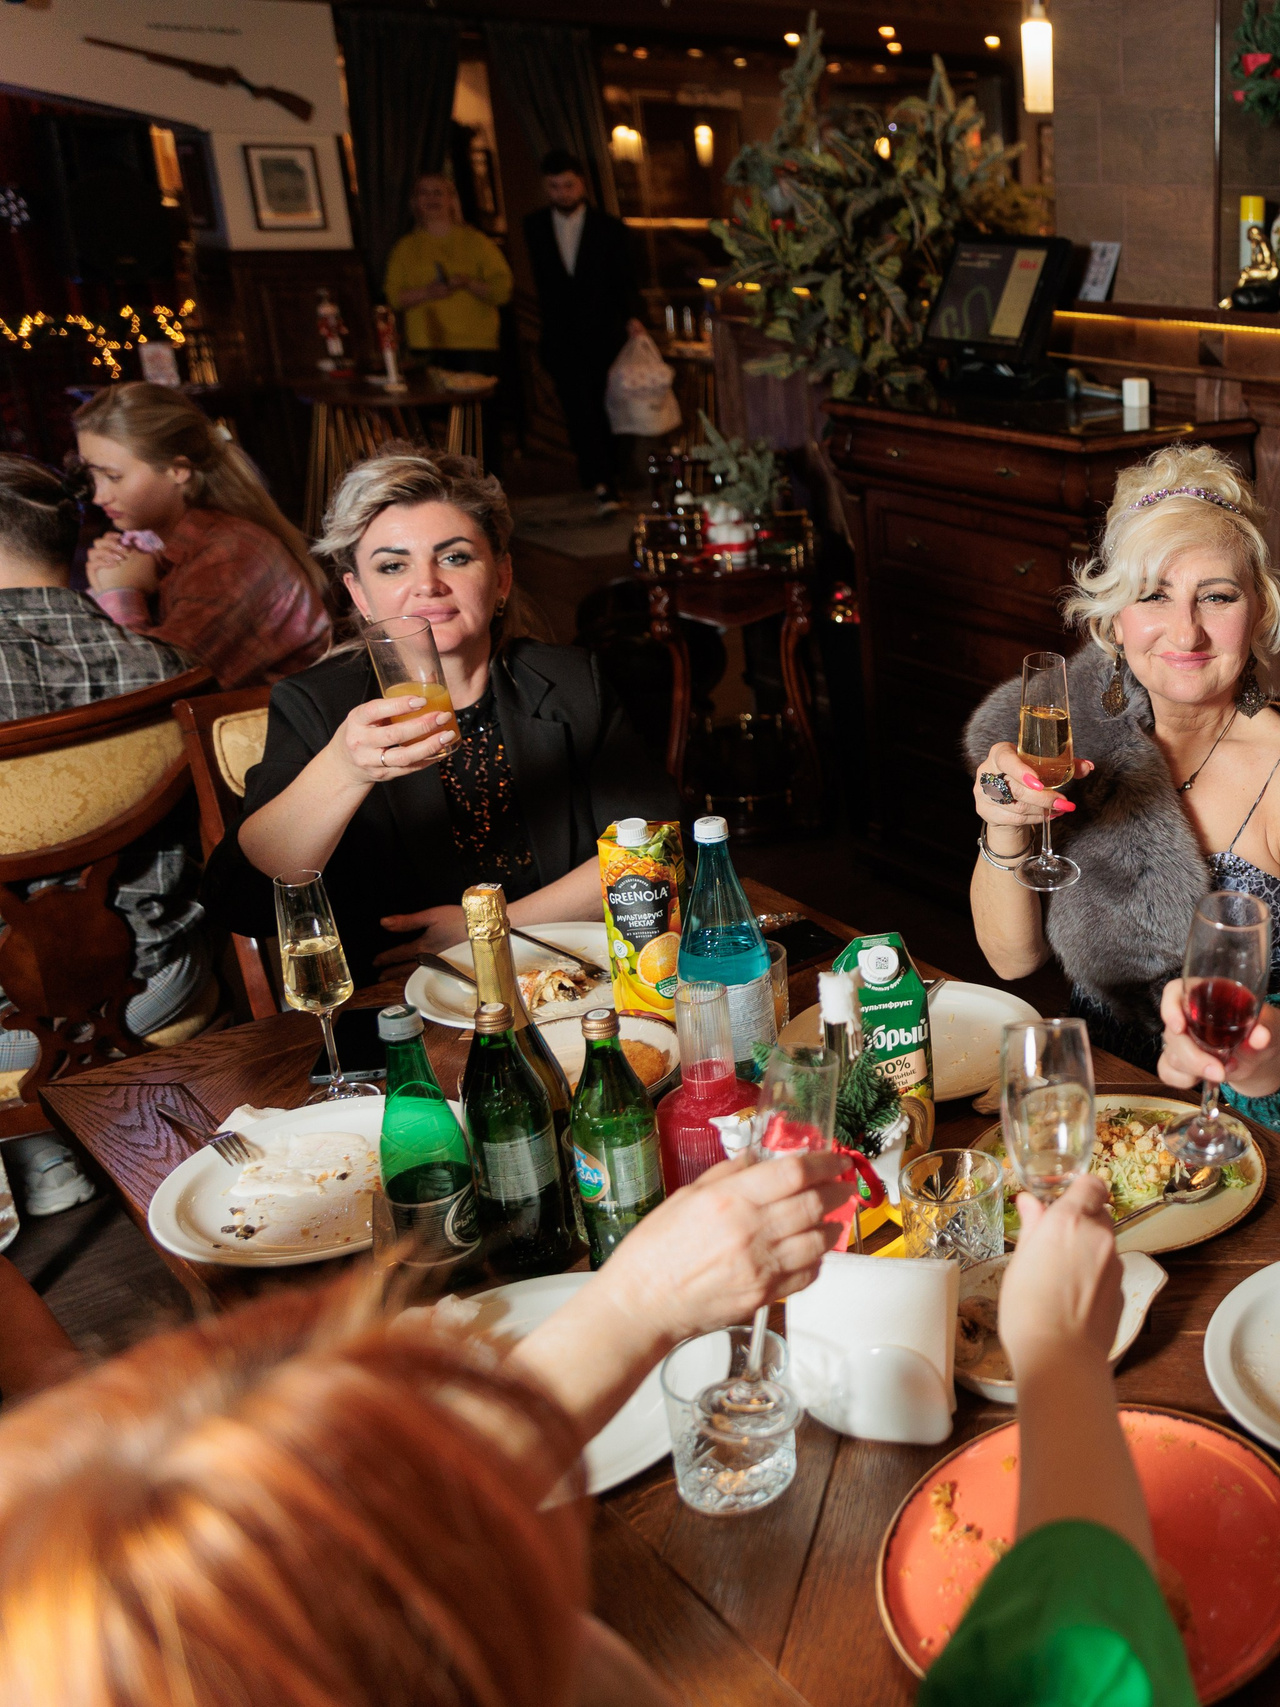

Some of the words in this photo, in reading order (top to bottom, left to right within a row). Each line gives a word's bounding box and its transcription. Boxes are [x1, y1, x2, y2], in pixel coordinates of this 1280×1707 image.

[609, 886, 668, 905] GREENOLA
[617, 909, 664, 922] МУЛЬТИФРУКТ
[628, 919, 655, 928] НЕКТАР
[872, 1018, 929, 1051] брый
[577, 1168, 606, 1184] ЗАН
[454, 1209, 477, 1231] РЫЧ
